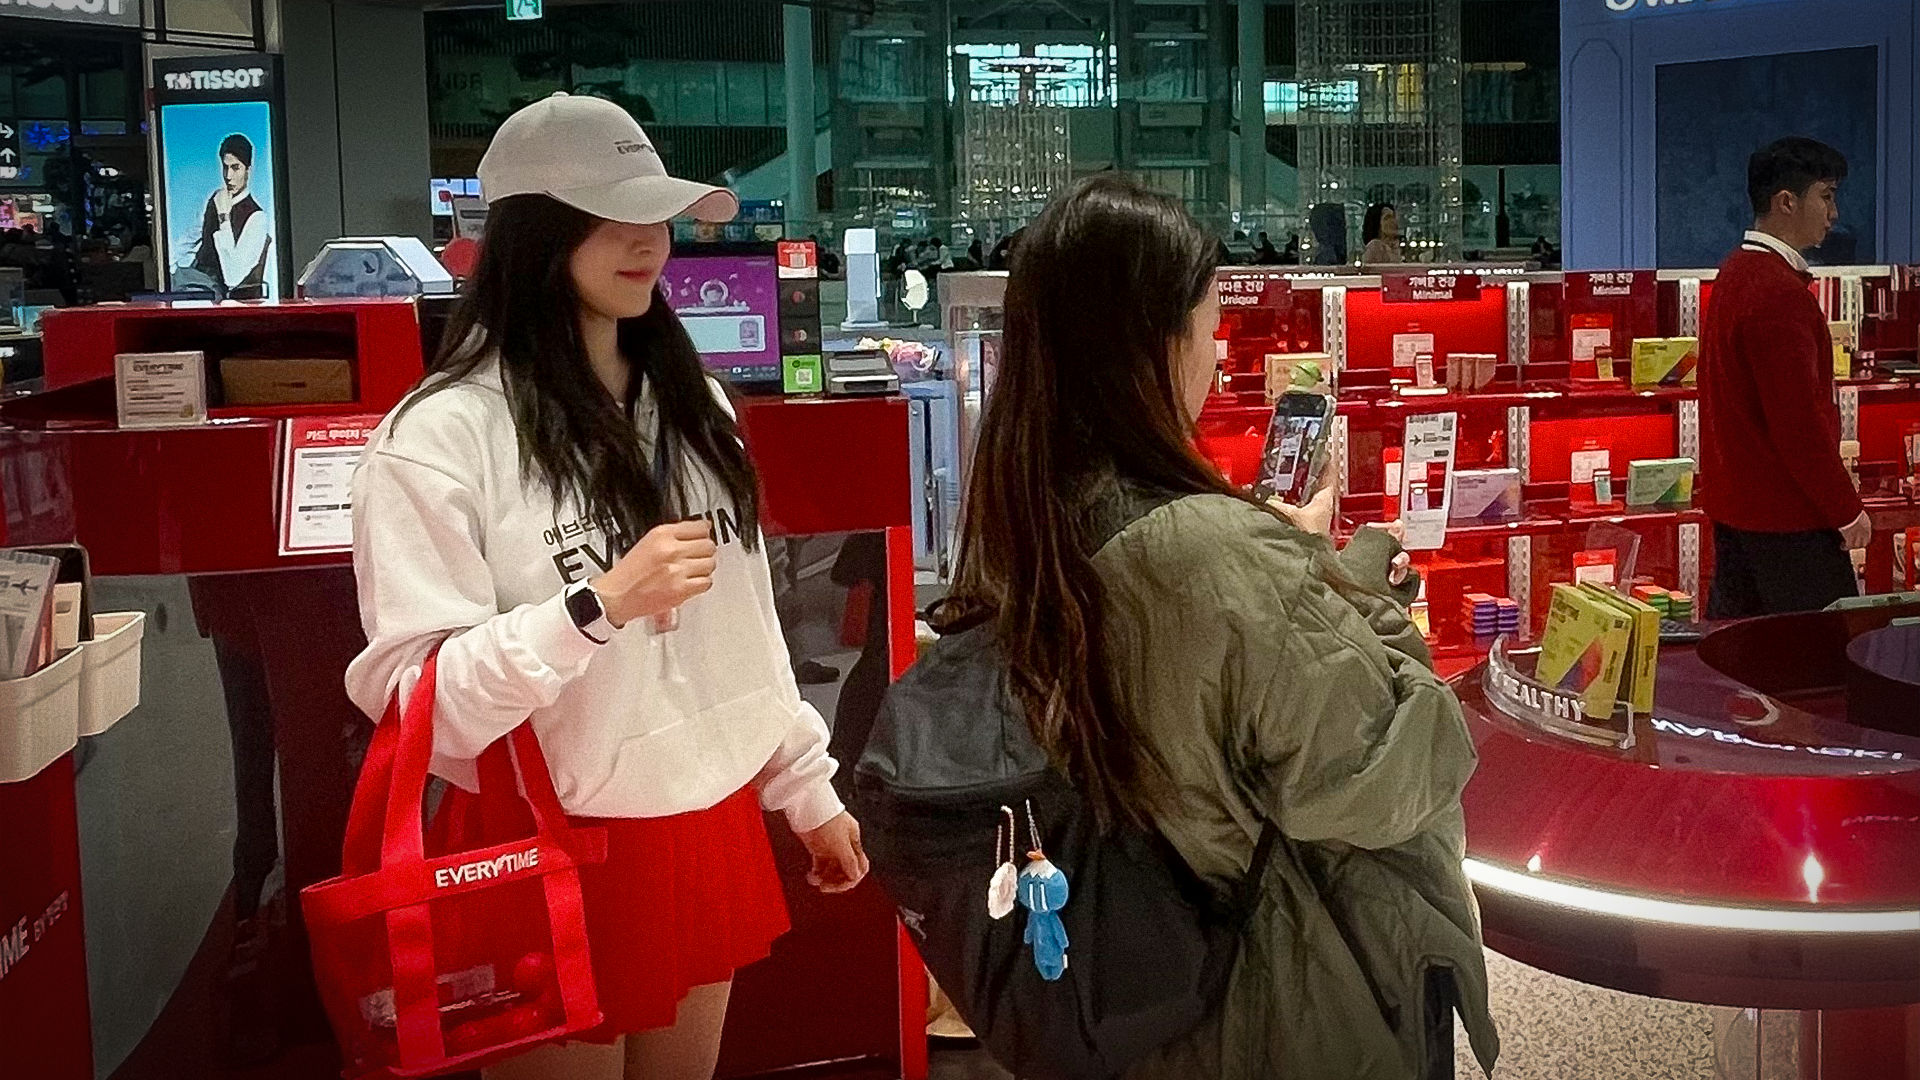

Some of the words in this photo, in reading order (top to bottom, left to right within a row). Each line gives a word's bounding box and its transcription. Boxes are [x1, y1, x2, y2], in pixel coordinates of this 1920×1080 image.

[191, 67, 264, 90] TISSOT
[1412, 290, 1453, 300] Minimal
[1593, 285, 1630, 295] Minimal
[1220, 295, 1259, 305] Unique
